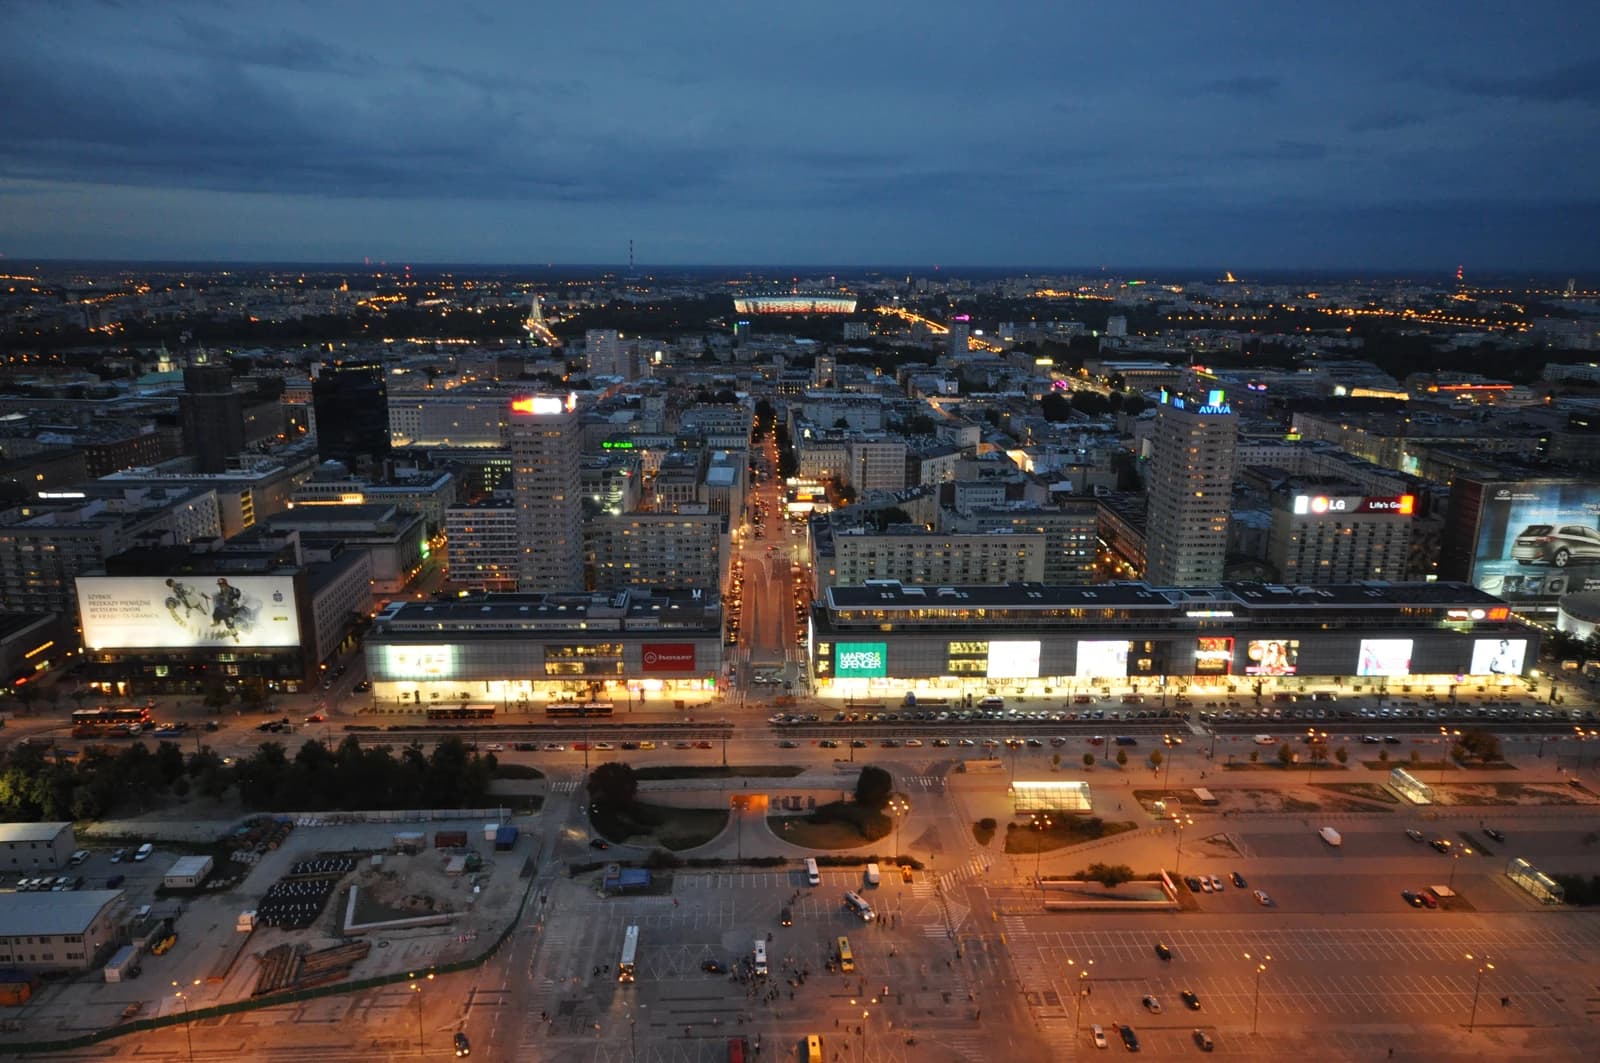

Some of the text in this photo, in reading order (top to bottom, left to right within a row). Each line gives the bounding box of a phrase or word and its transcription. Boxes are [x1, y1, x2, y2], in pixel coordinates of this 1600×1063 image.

[1199, 405, 1231, 414] AVIVA
[1329, 500, 1346, 510] LG
[839, 660, 881, 669] SPENCER
